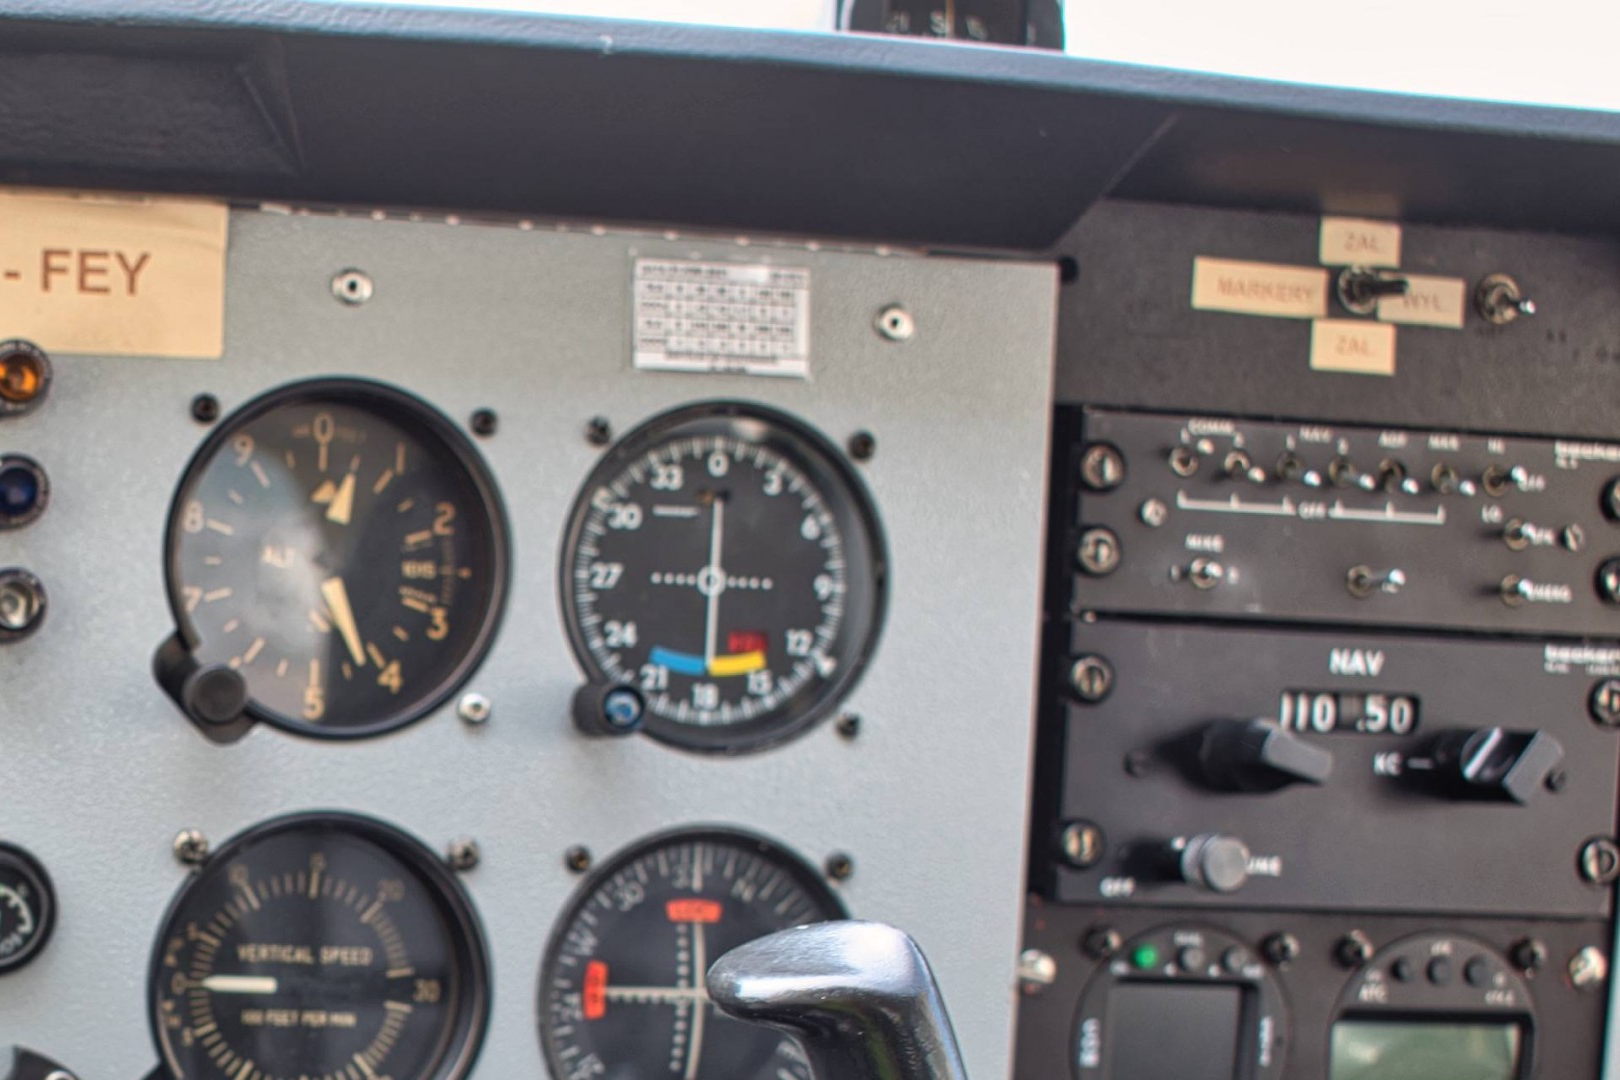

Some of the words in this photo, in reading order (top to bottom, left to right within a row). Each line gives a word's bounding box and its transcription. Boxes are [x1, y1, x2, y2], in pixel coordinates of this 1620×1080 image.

[40, 249, 151, 295] FEY
[313, 413, 334, 444] 0
[234, 434, 255, 465] 9
[708, 453, 728, 477] 0
[649, 466, 683, 491] 33
[763, 471, 782, 496] 3
[183, 502, 204, 533] 8
[433, 502, 456, 536] 2
[608, 504, 642, 530] 30
[800, 515, 820, 541] 6
[590, 563, 624, 589] 27
[814, 575, 831, 600] 9
[426, 608, 448, 641] 3
[604, 622, 637, 647] 24
[786, 629, 812, 654] 12
[1329, 648, 1385, 676] NAV
[378, 660, 403, 694] 4
[640, 665, 669, 690] 21
[747, 670, 773, 696] 15
[303, 684, 325, 721] 5
[693, 683, 718, 709] 18
[237, 943, 315, 965] VERTICAL
[320, 946, 374, 966] SPEED
